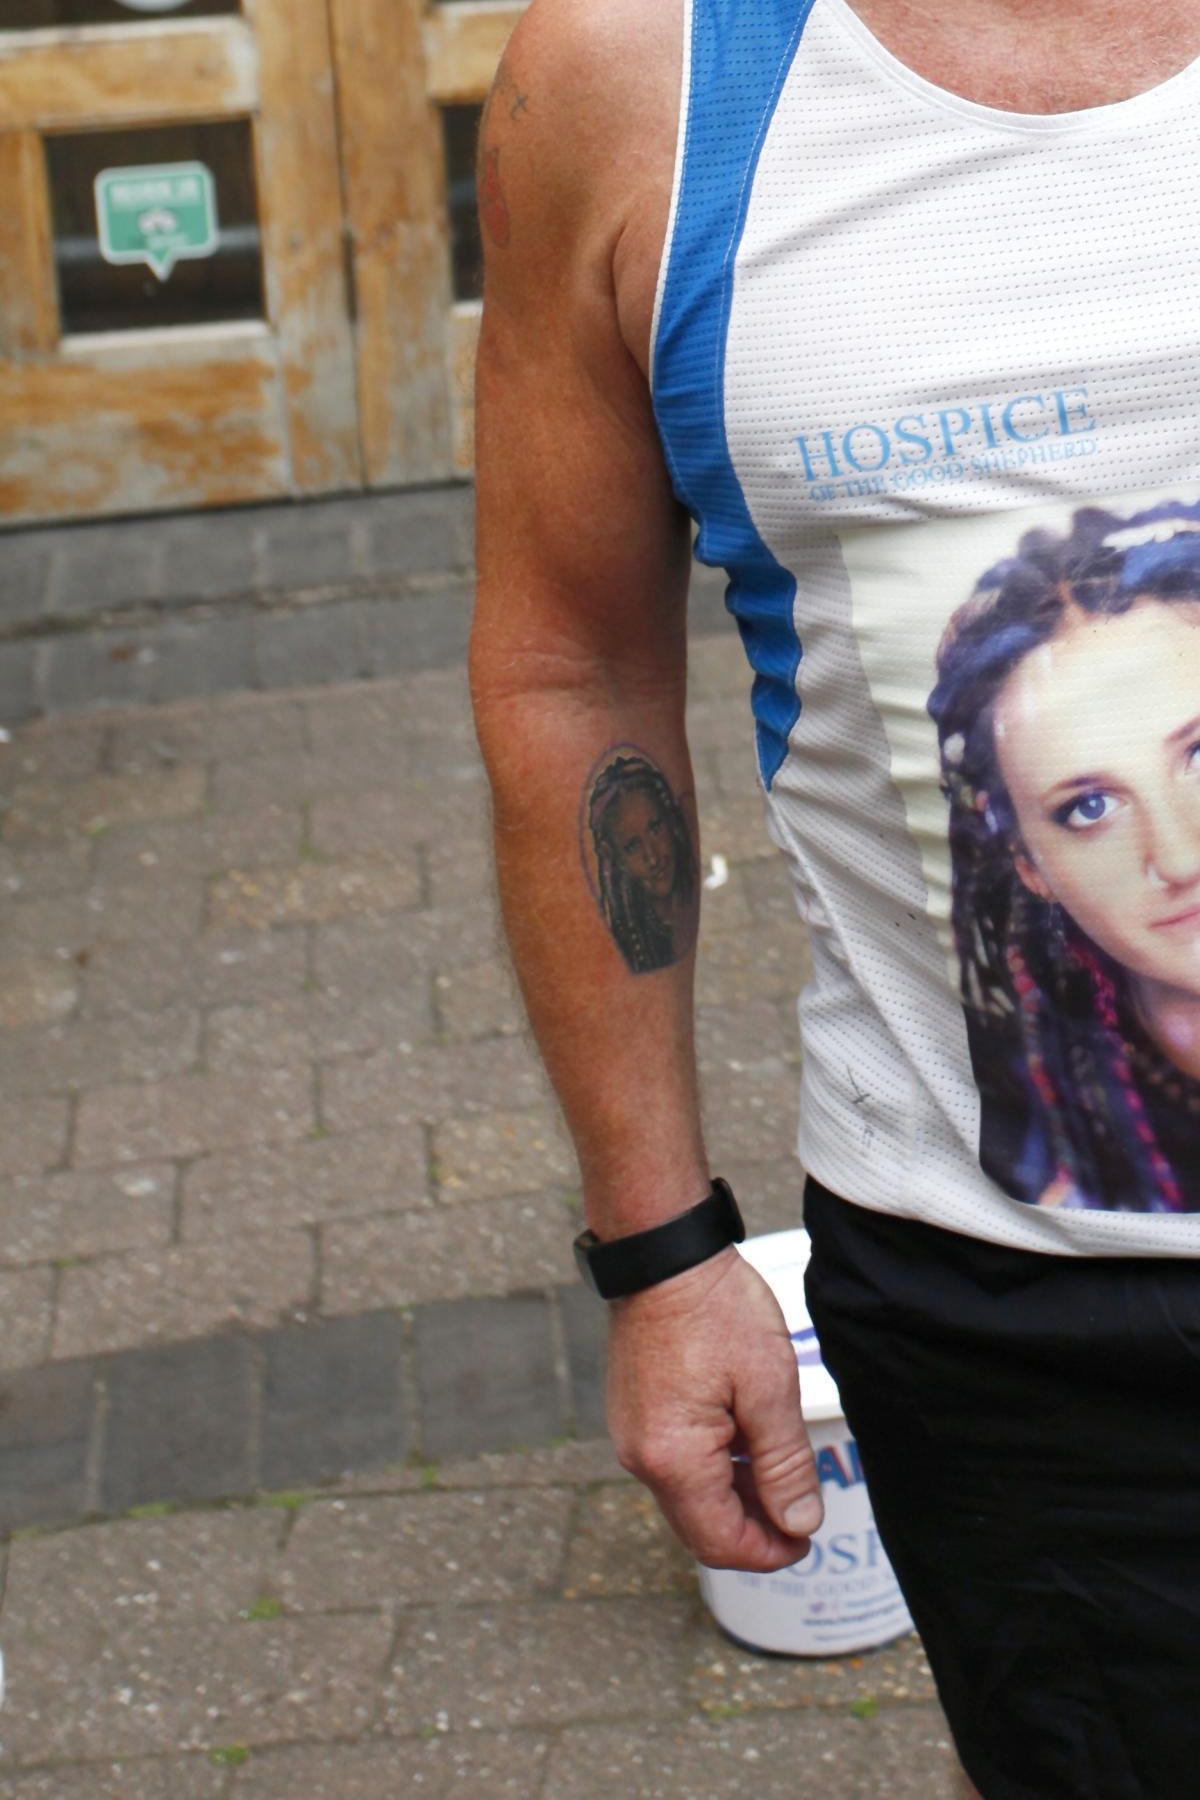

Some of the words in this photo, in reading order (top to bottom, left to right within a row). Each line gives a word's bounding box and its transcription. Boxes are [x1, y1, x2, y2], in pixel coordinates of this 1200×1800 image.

[793, 387, 1097, 482] HOSPICE
[810, 484, 836, 502] OF
[838, 475, 885, 500] THE
[893, 462, 965, 490] GOOD
[971, 438, 1098, 476] SHEPHERD
